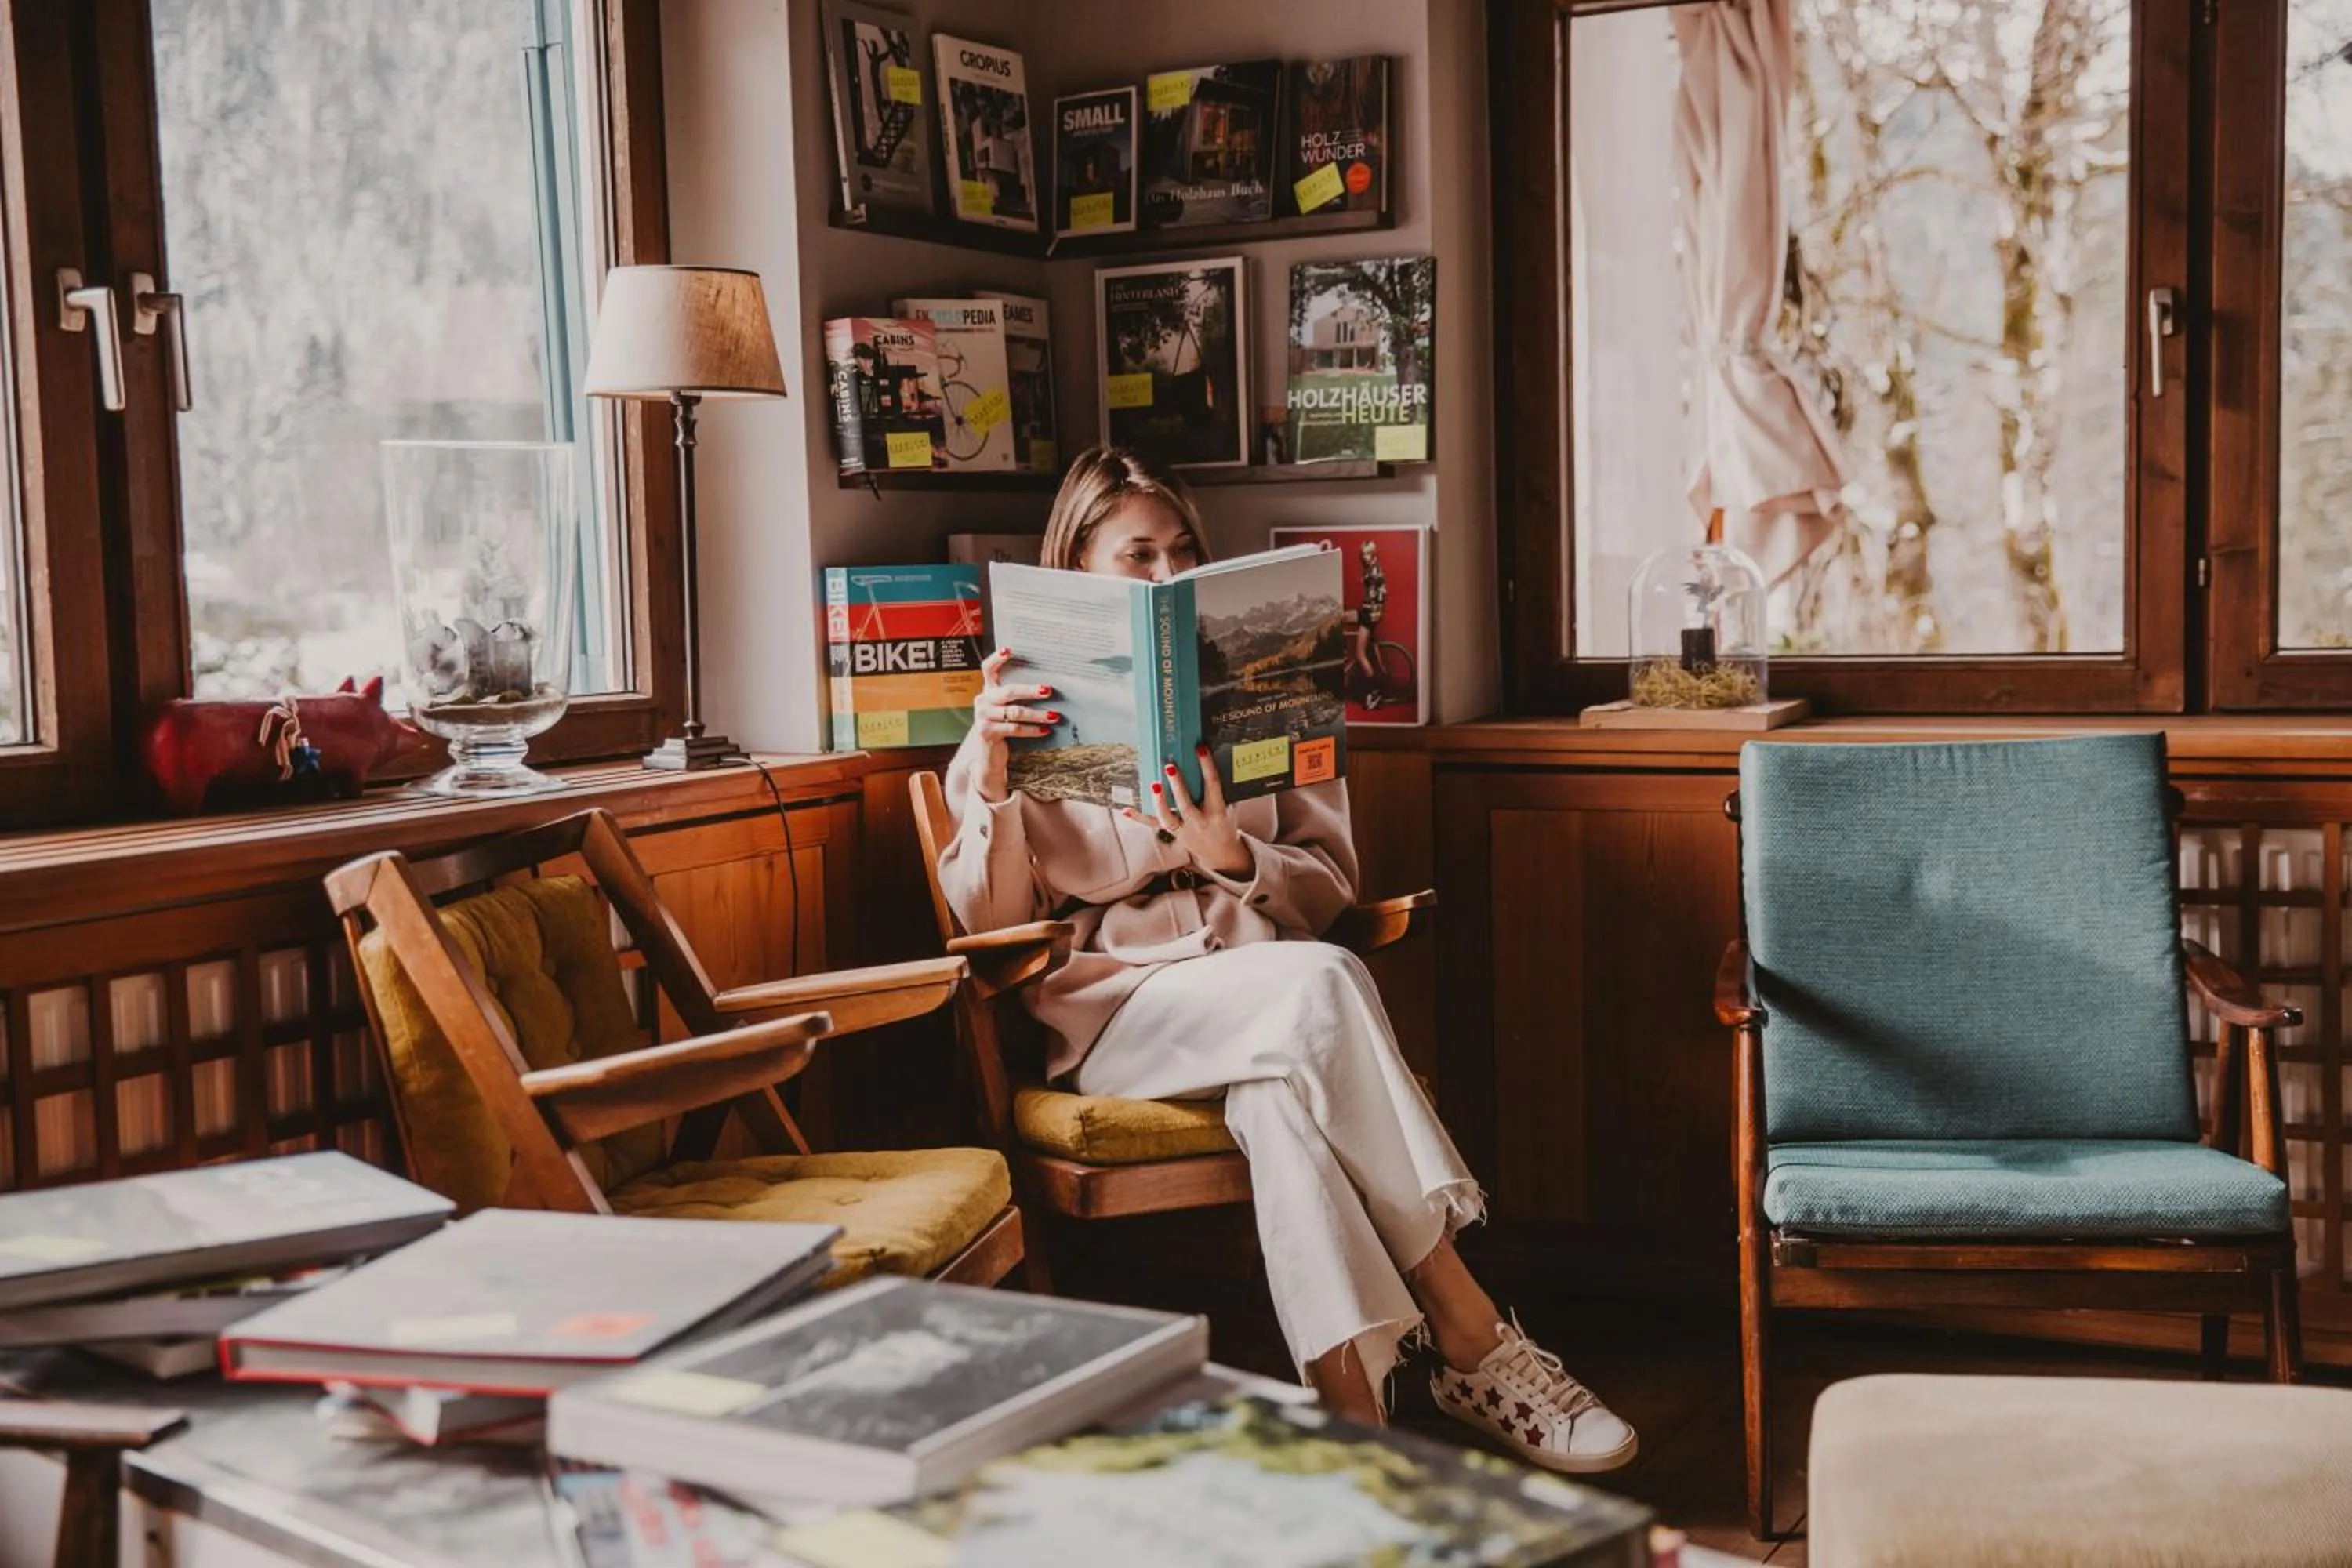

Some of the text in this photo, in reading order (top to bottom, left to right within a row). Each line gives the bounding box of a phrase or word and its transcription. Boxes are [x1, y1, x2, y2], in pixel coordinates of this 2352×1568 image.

[1063, 103, 1124, 131] SMALL
[1301, 130, 1341, 149] HOLZ
[1301, 143, 1366, 163] WUNDER
[1230, 179, 1263, 196] Buch
[873, 335, 915, 346] CABINS
[838, 371, 853, 422] CABINS
[1287, 381, 1427, 408] HOLZHÄUSER
[1341, 404, 1410, 424] HEUTE
[1160, 595, 1170, 614] THE
[1160, 616, 1171, 657] SOUND
[855, 641, 937, 673] BIKE!
[1162, 659, 1173, 673] OF
[1229, 707, 1261, 720] SOUND
[1264, 703, 1276, 713] OF
